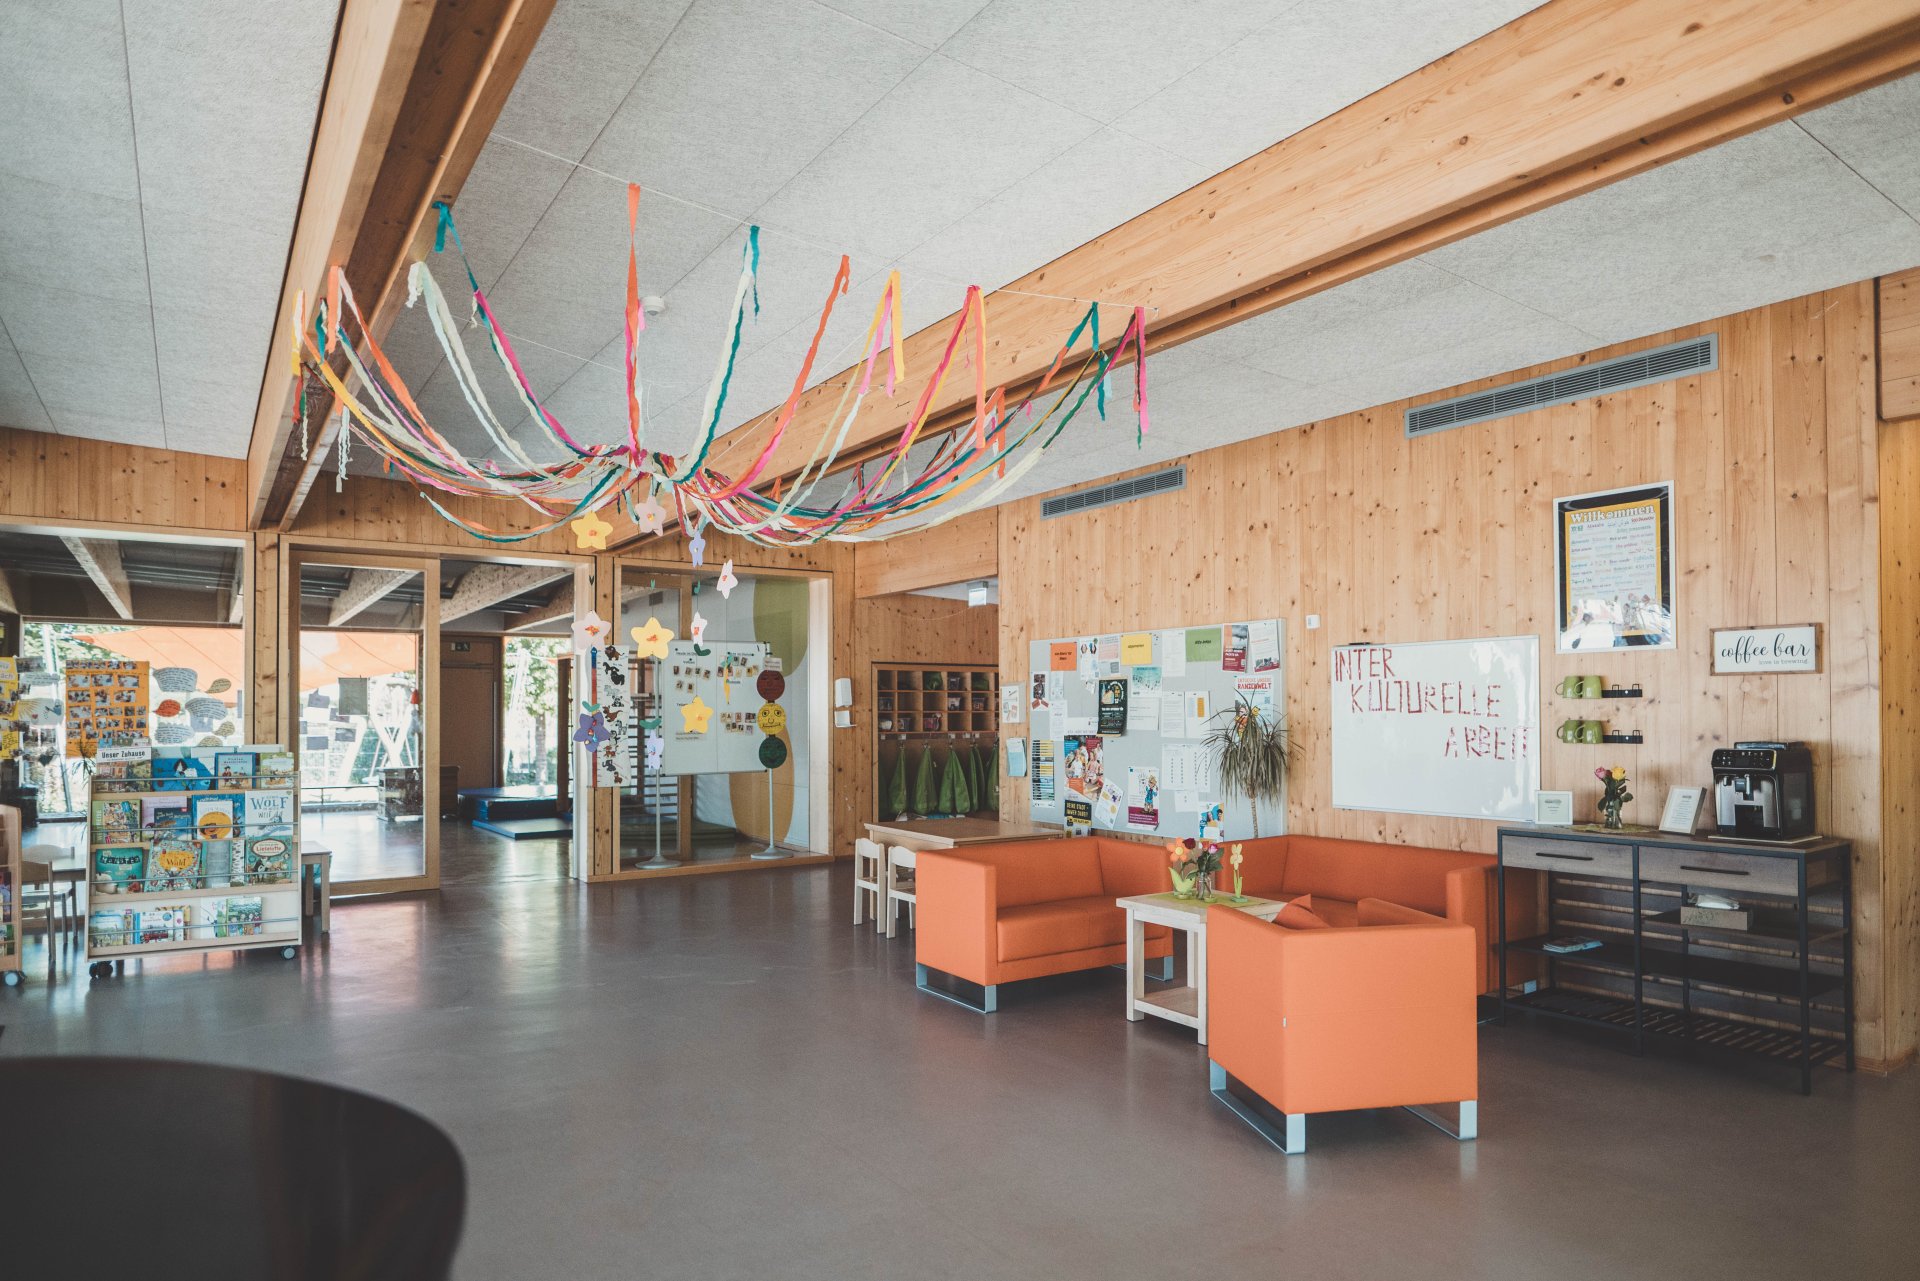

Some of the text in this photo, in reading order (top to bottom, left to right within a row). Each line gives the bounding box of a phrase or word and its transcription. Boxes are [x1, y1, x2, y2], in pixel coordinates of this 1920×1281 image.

[1570, 505, 1655, 524] Willkommen
[1721, 632, 1810, 664] coffee bar
[1334, 647, 1395, 682] INTER
[1350, 680, 1502, 718] KULTURELLE
[101, 750, 146, 759] Unser Zuhause
[1443, 724, 1536, 760] ARBEIT
[250, 796, 289, 810] WOLF
[166, 858, 186, 866] Wald
